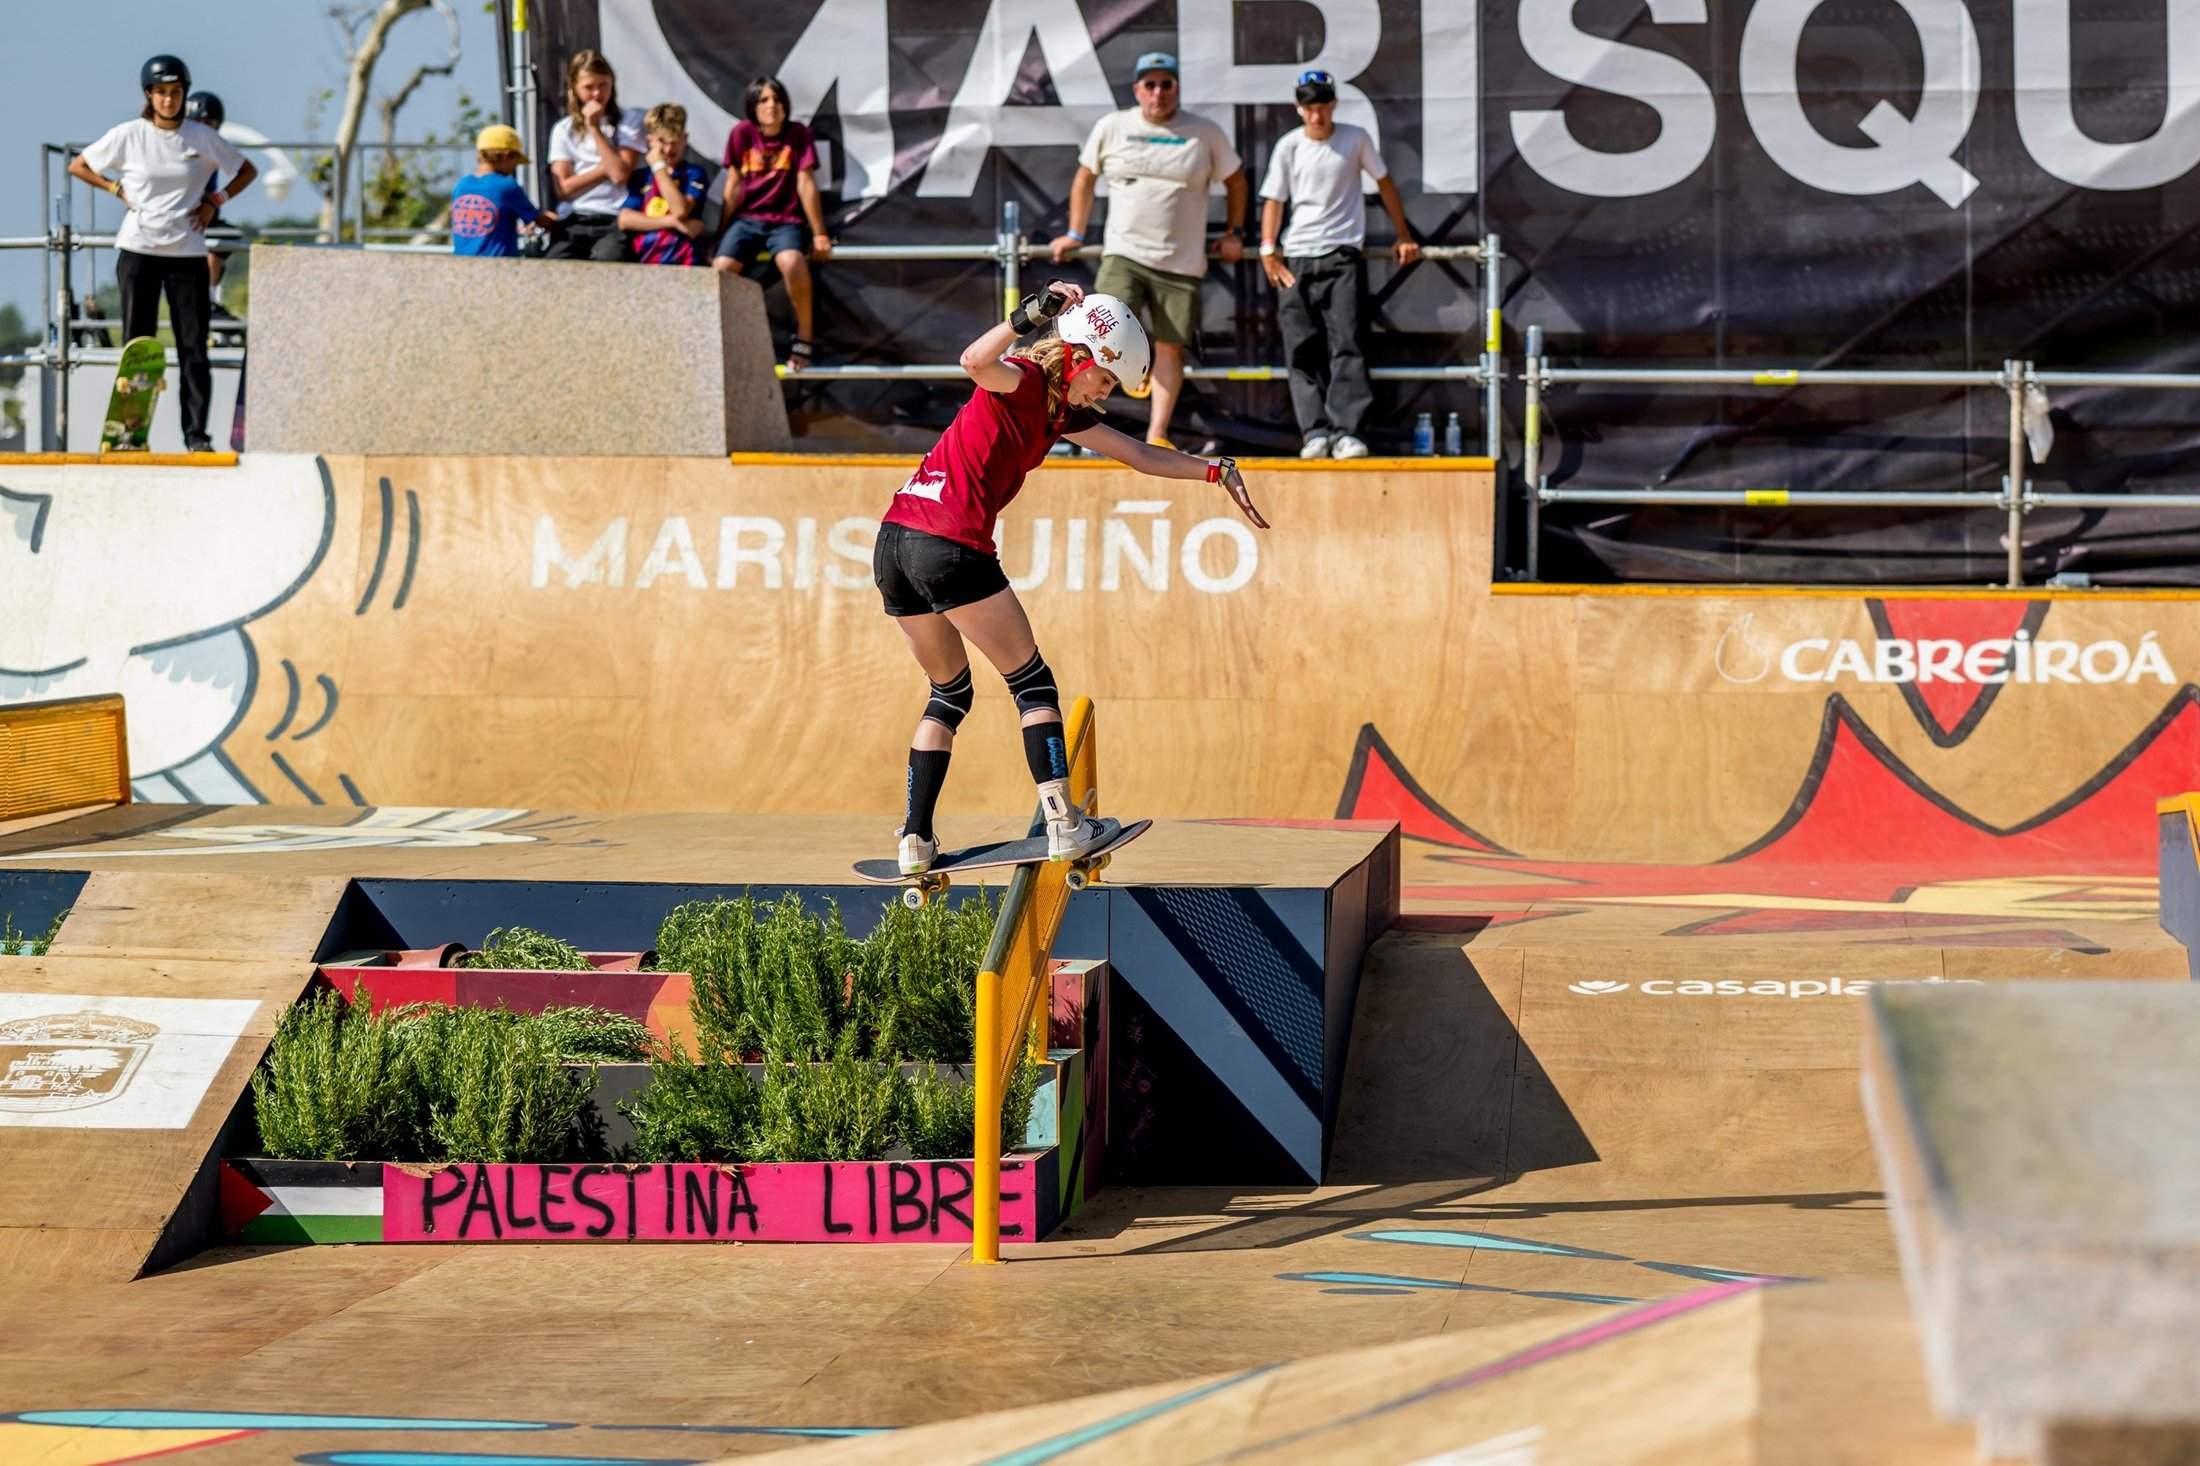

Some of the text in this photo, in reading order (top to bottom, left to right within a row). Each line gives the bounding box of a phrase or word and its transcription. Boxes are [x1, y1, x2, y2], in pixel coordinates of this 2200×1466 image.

[1086, 309, 1111, 337] TRICKY
[1095, 305, 1120, 330] LITTLE
[530, 500, 1259, 595] MARISUIÑO
[422, 1163, 759, 1240] PALESTINA
